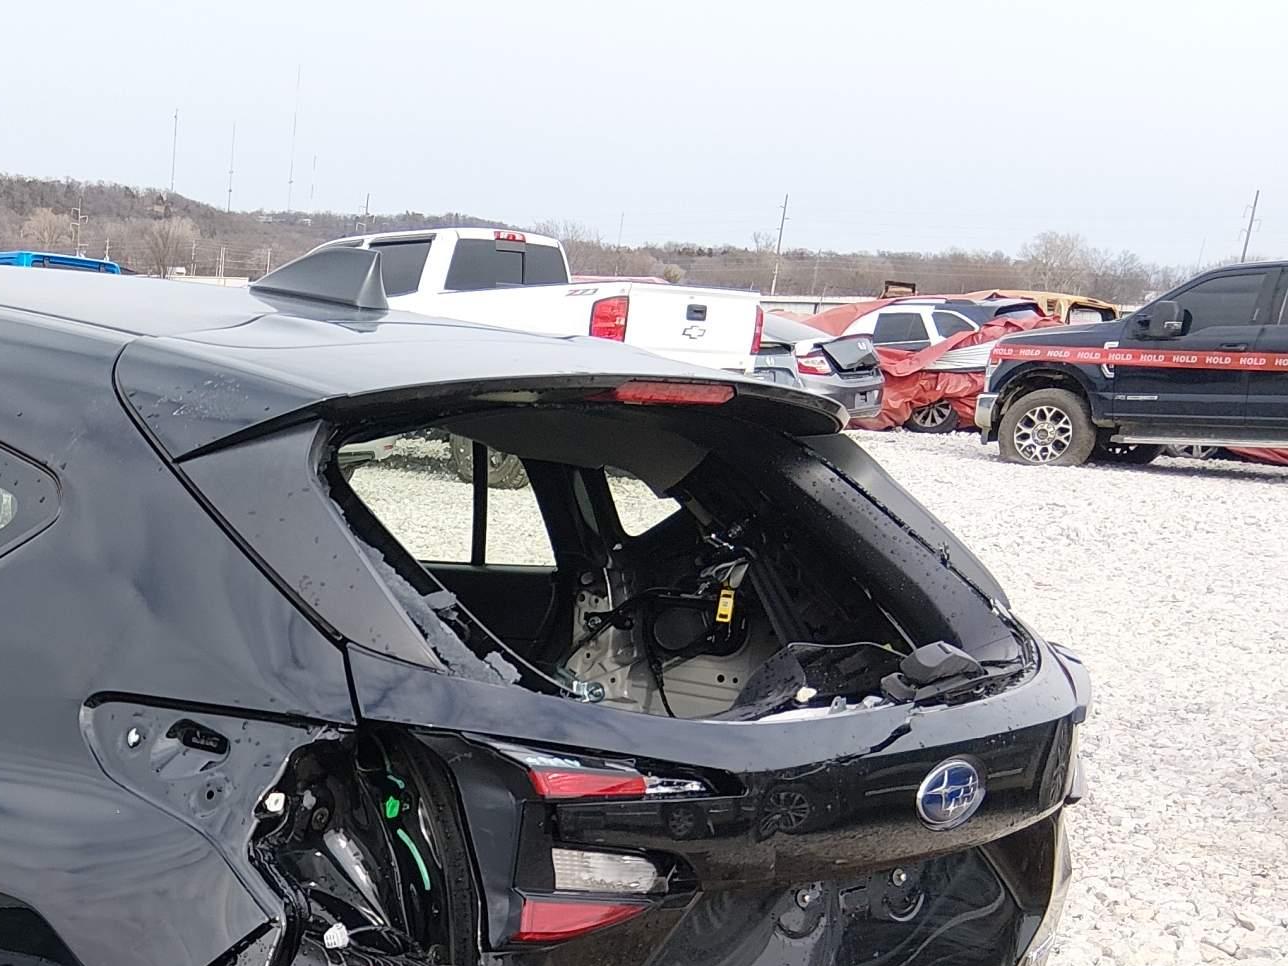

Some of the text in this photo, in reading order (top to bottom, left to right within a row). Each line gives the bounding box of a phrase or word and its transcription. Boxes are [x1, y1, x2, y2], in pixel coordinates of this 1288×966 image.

[1140, 354, 1165, 362] HOLD
[1173, 355, 1197, 363] HOLD
[1206, 356, 1231, 364] HOLD
[1239, 357, 1266, 365] HOLD
